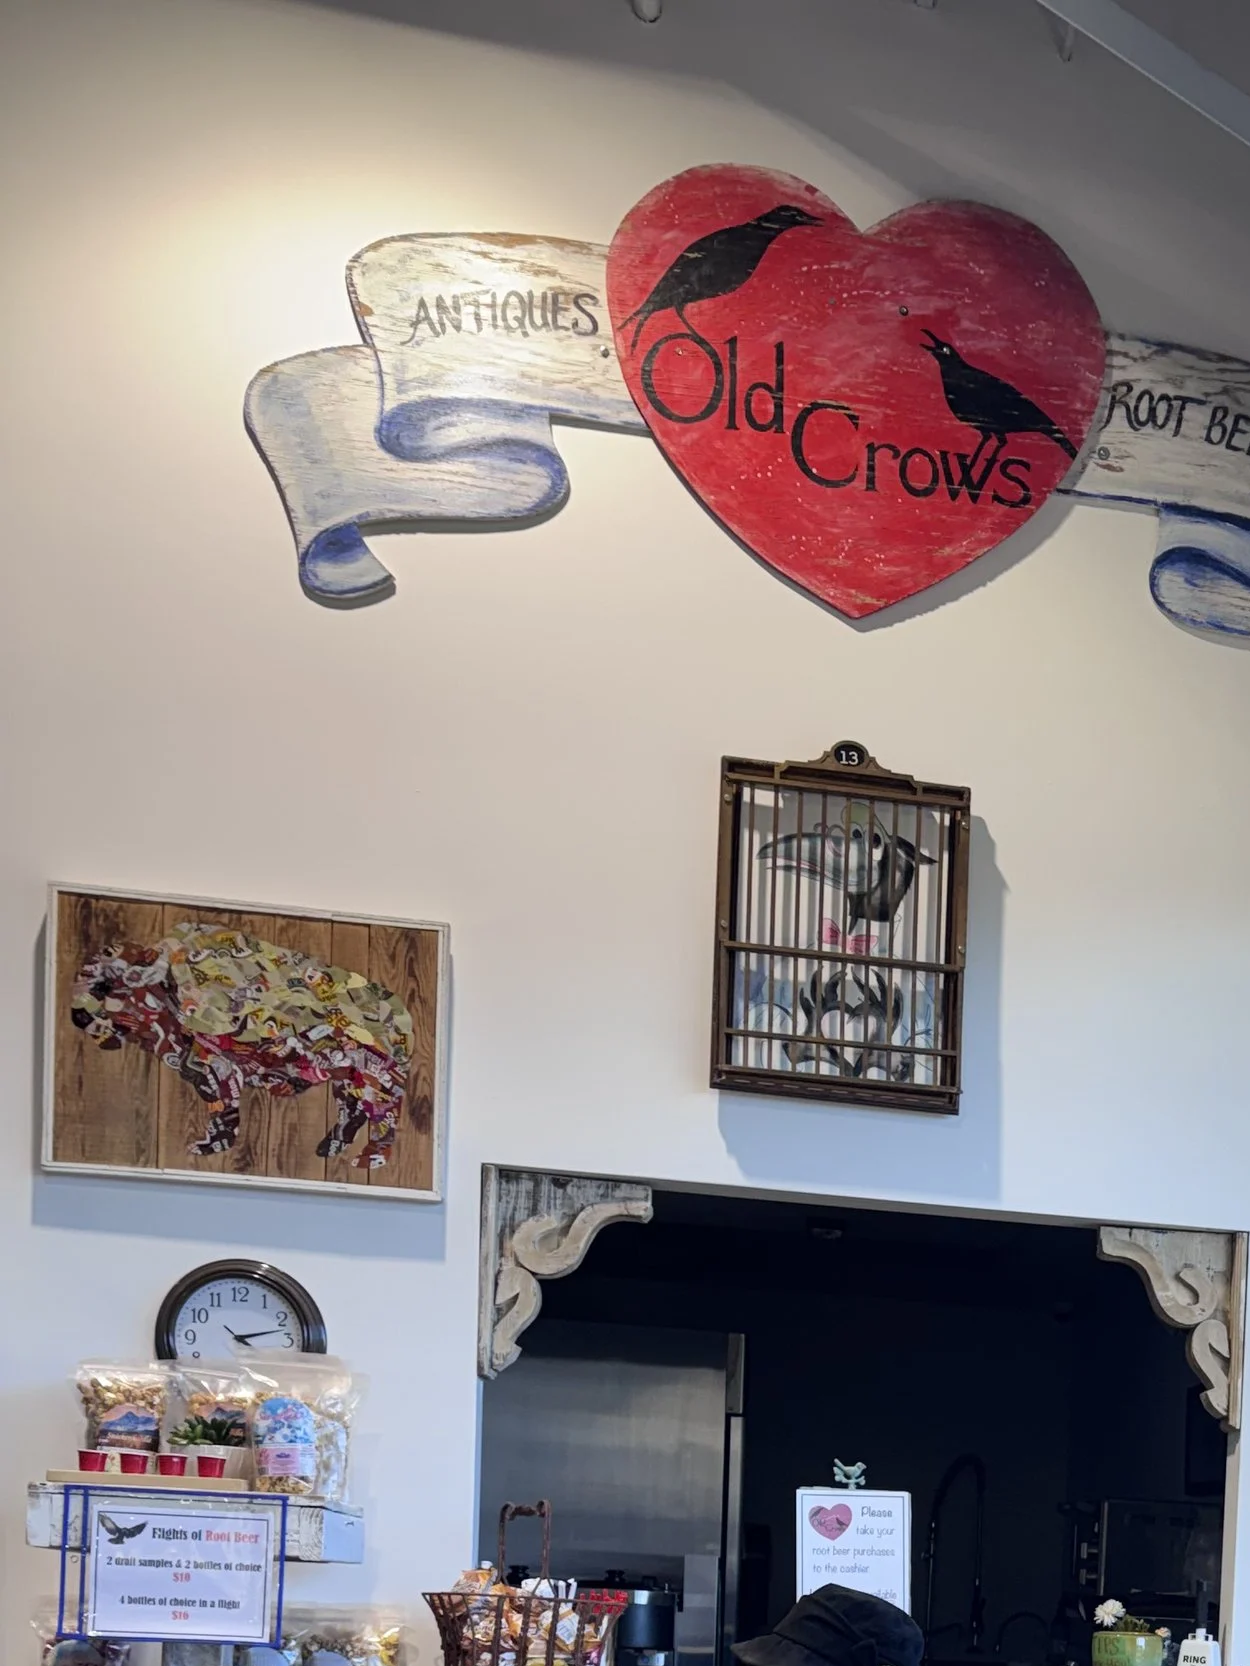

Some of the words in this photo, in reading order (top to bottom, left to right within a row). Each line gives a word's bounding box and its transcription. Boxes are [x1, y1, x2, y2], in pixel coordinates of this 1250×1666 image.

[400, 290, 599, 345] ANTIQUES
[641, 333, 785, 434] Old
[1100, 382, 1204, 437] ROOT
[791, 401, 1031, 508] Crows
[840, 750, 858, 765] 13
[209, 1292, 222, 1308] 11
[231, 1286, 249, 1302] 12
[262, 1294, 268, 1309] 1
[192, 1308, 209, 1324] 10
[275, 1311, 288, 1327] 2
[185, 1329, 197, 1345] 9
[281, 1333, 294, 1348] 3
[861, 1506, 893, 1518] Please
[152, 1527, 188, 1541] Flights
[191, 1528, 202, 1541] of
[205, 1530, 231, 1542] Root
[234, 1532, 260, 1544] Beer
[856, 1525, 875, 1535] take
[876, 1527, 895, 1538] your
[812, 1547, 830, 1555] root
[832, 1546, 850, 1556] beer
[853, 1547, 895, 1559] purchases
[106, 1556, 113, 1566] 2
[138, 1557, 173, 1569] samples
[175, 1558, 182, 1568] &
[184, 1559, 191, 1569] 2
[193, 1559, 222, 1571] bottles
[224, 1561, 233, 1571] of
[235, 1562, 262, 1572] choice
[813, 1563, 822, 1573] to
[824, 1563, 837, 1573] the
[172, 1572, 190, 1583] $10
[119, 1595, 125, 1605] 4
[127, 1595, 156, 1606] bottles
[158, 1597, 167, 1606] of
[169, 1596, 196, 1607] choice
[199, 1599, 207, 1609] in
[171, 1610, 189, 1621] $16
[1183, 1655, 1206, 1664] RING
